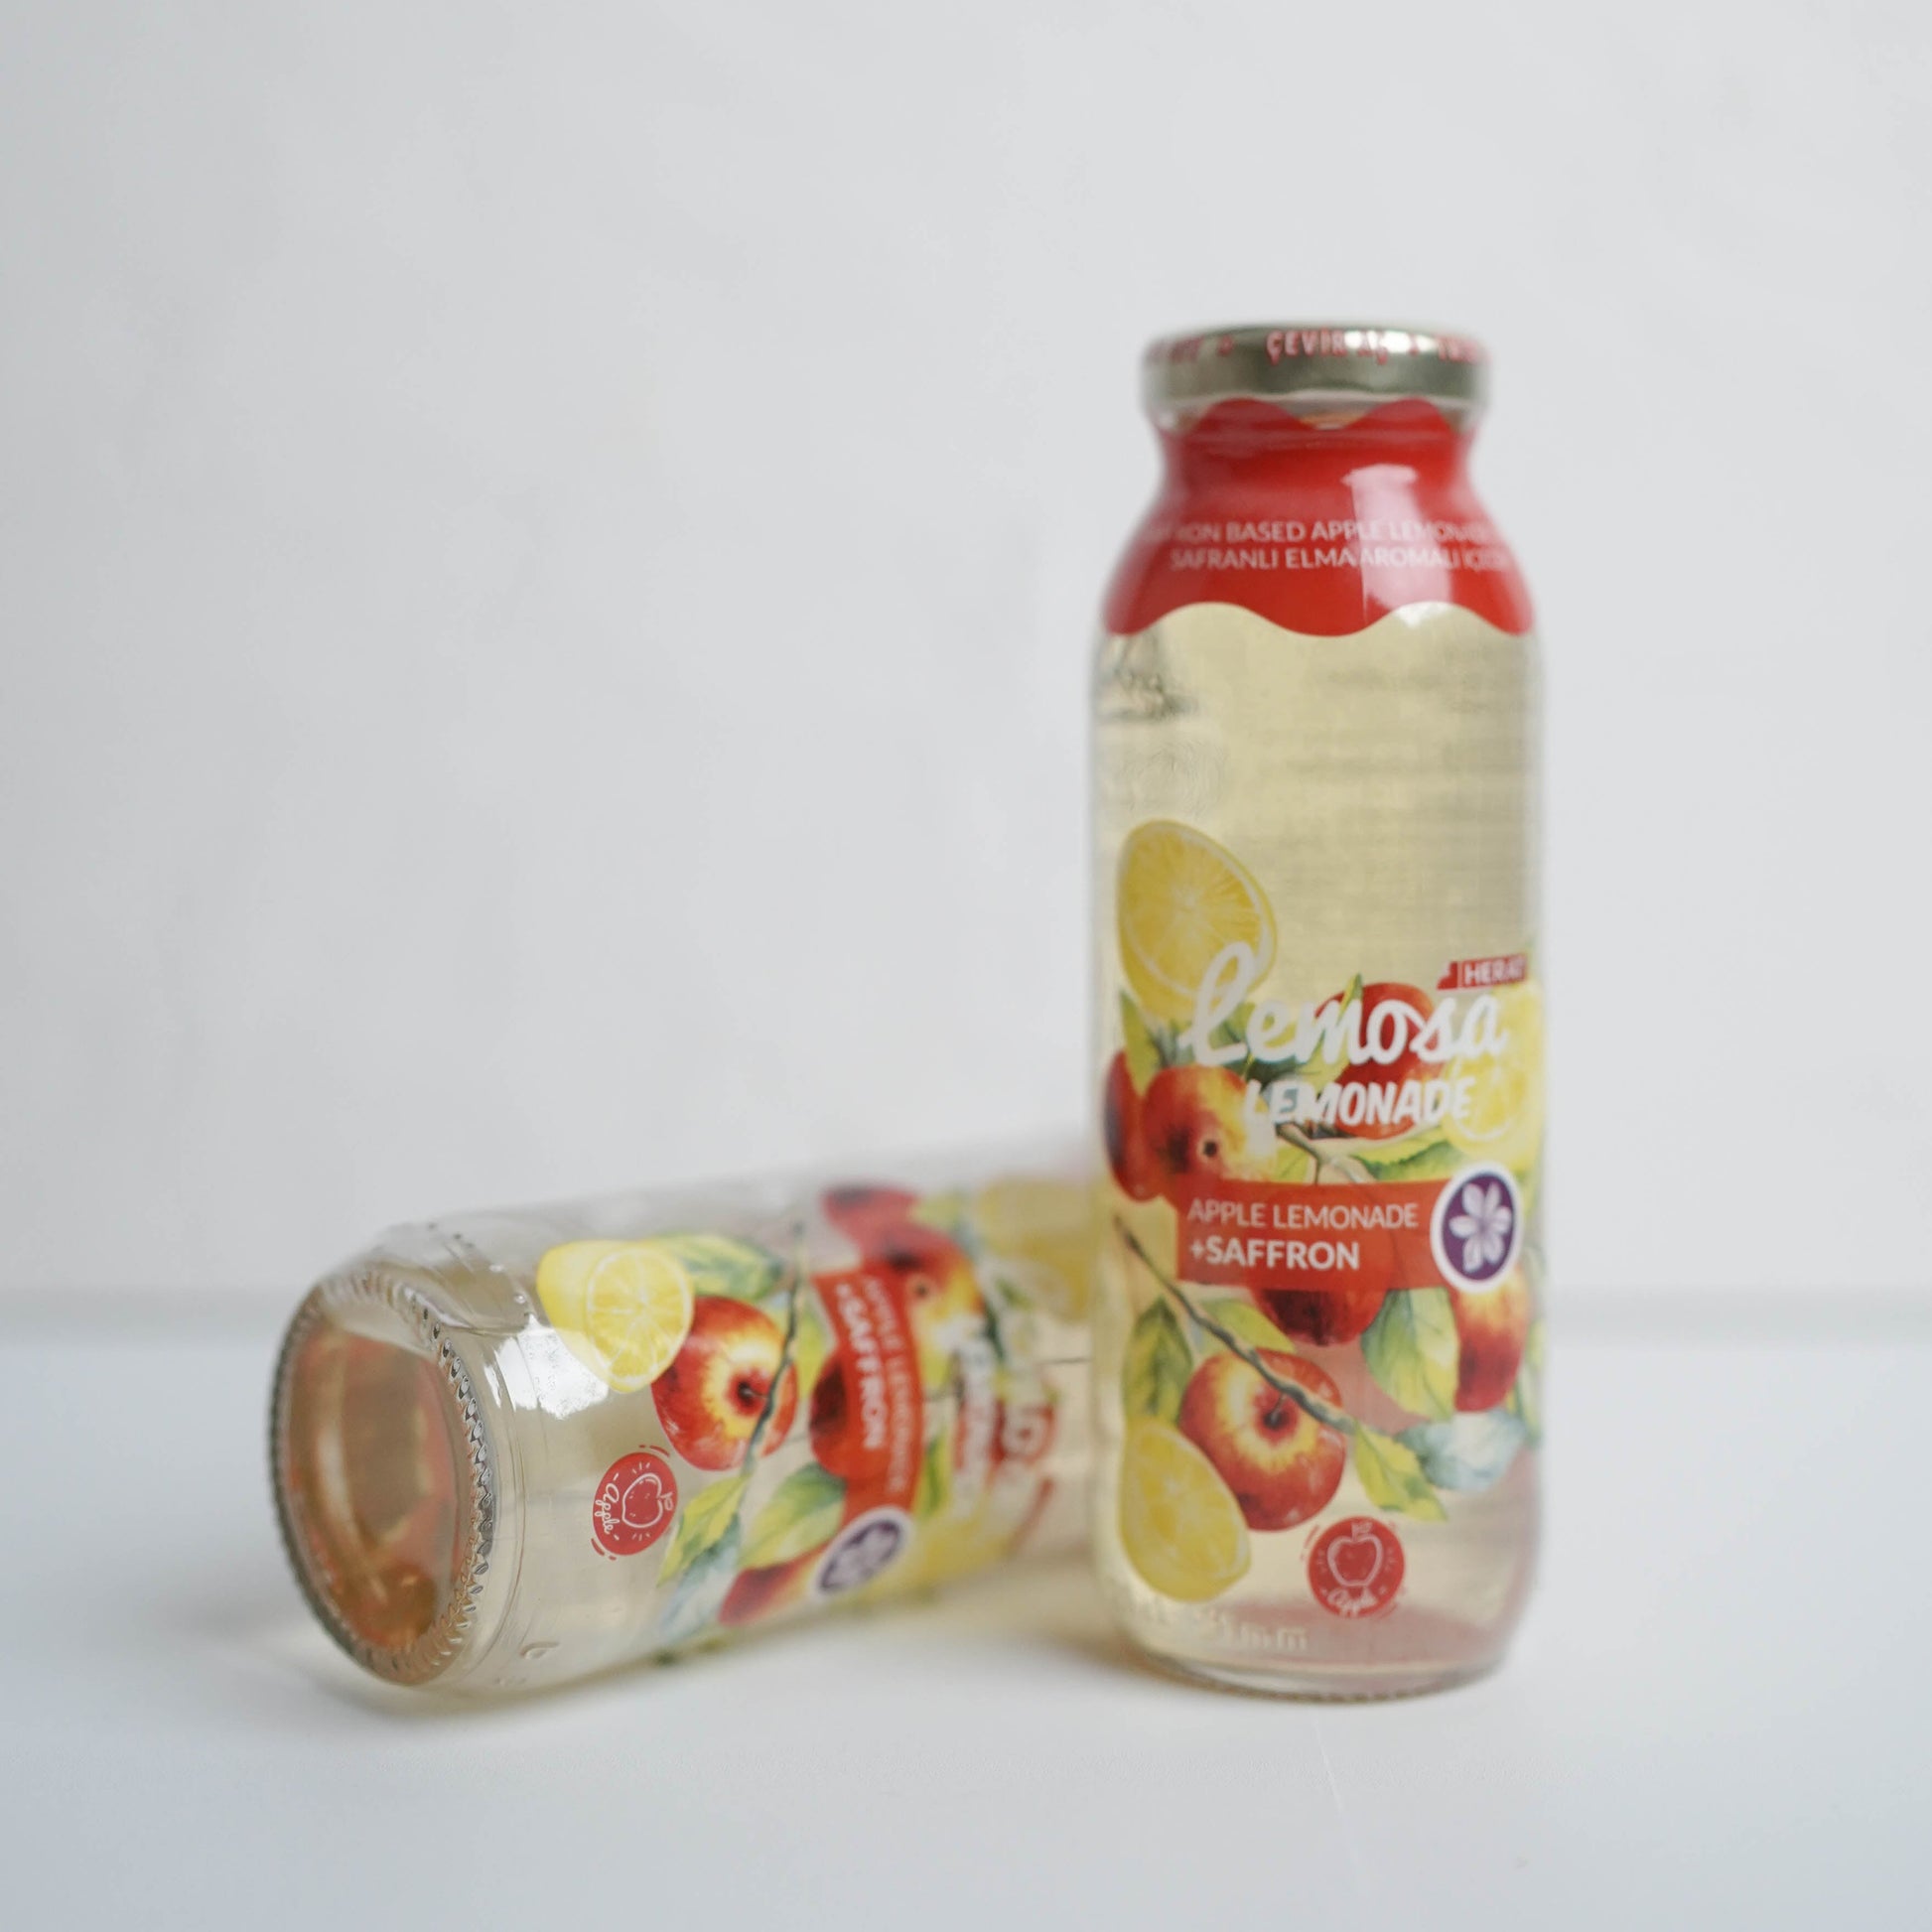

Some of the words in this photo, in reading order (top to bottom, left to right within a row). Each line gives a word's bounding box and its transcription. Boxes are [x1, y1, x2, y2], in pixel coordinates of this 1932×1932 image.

[1226, 521, 1306, 543] BASED
[1311, 520, 1382, 542] APPLE
[1285, 546, 1357, 569] ELMA
[1243, 1075, 1476, 1126] LEMONADE
[1187, 1197, 1265, 1229] APPLE
[1273, 1201, 1420, 1231] LEMONADE
[1190, 1235, 1360, 1271] +SAFFRON
